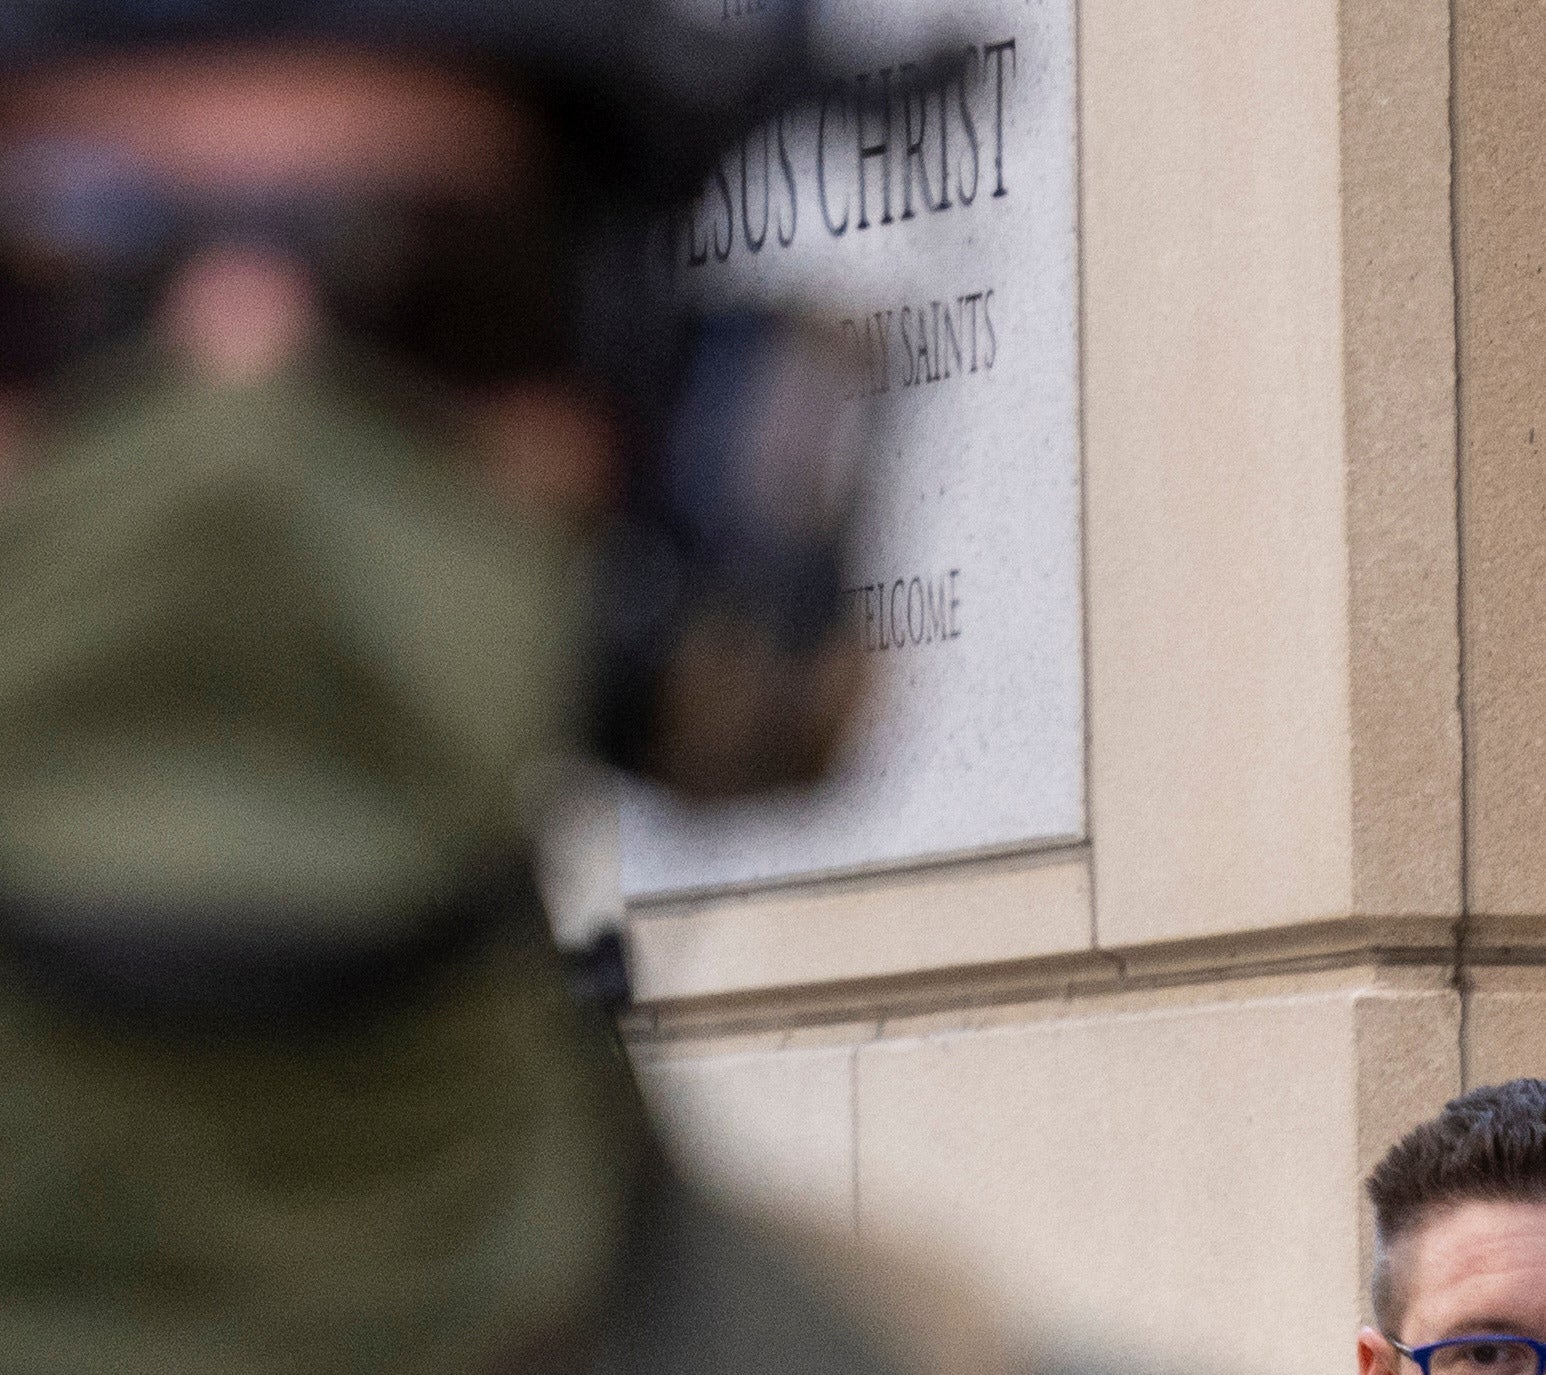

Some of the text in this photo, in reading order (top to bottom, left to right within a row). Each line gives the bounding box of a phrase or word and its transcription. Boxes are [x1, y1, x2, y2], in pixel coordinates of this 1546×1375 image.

[685, 38, 1017, 268] SUS CHRIST
[899, 289, 997, 388] SAINTS
[841, 569, 962, 653] ELCOME
